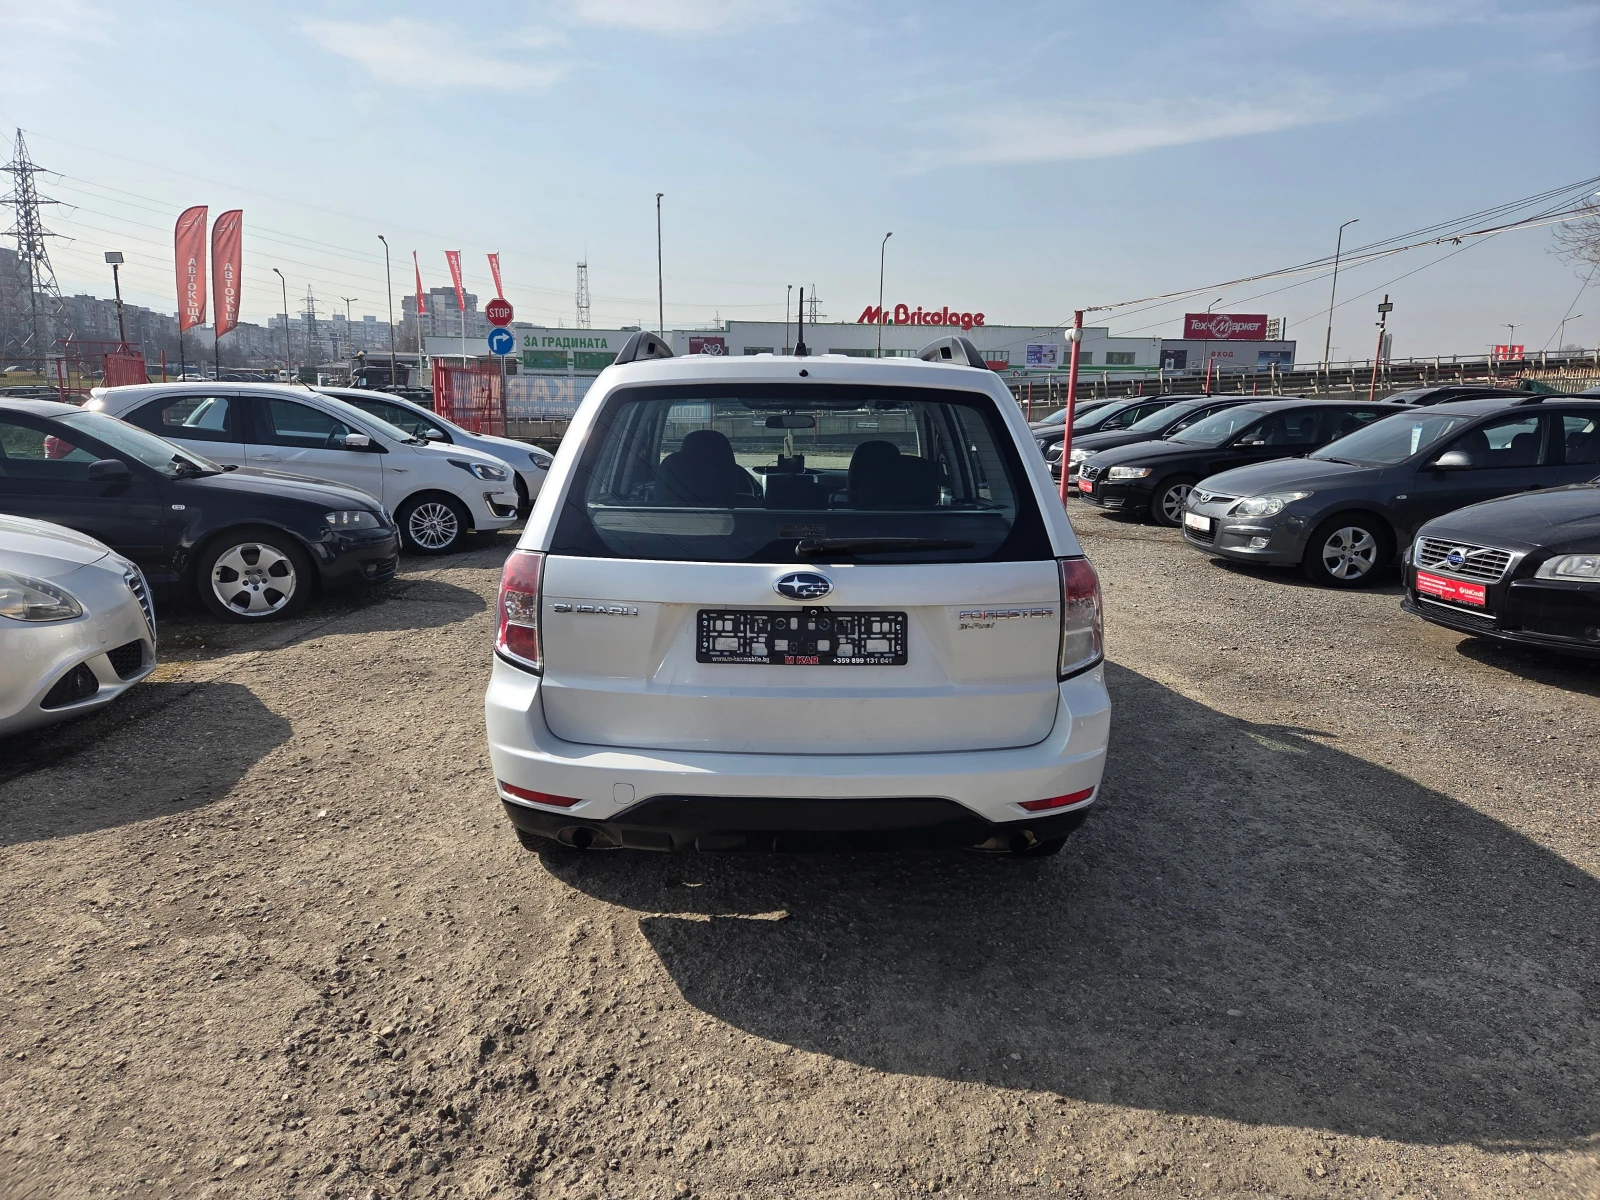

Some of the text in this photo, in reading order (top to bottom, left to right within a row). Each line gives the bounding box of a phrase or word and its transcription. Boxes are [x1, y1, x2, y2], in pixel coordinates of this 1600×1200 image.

[489, 307, 510, 318] STOP
[523, 335, 608, 349] ЗА ГРАДИНАТА
[553, 602, 639, 617] SUBARU
[959, 608, 1054, 620] FORESTER
[784, 655, 820, 665] M KAR
